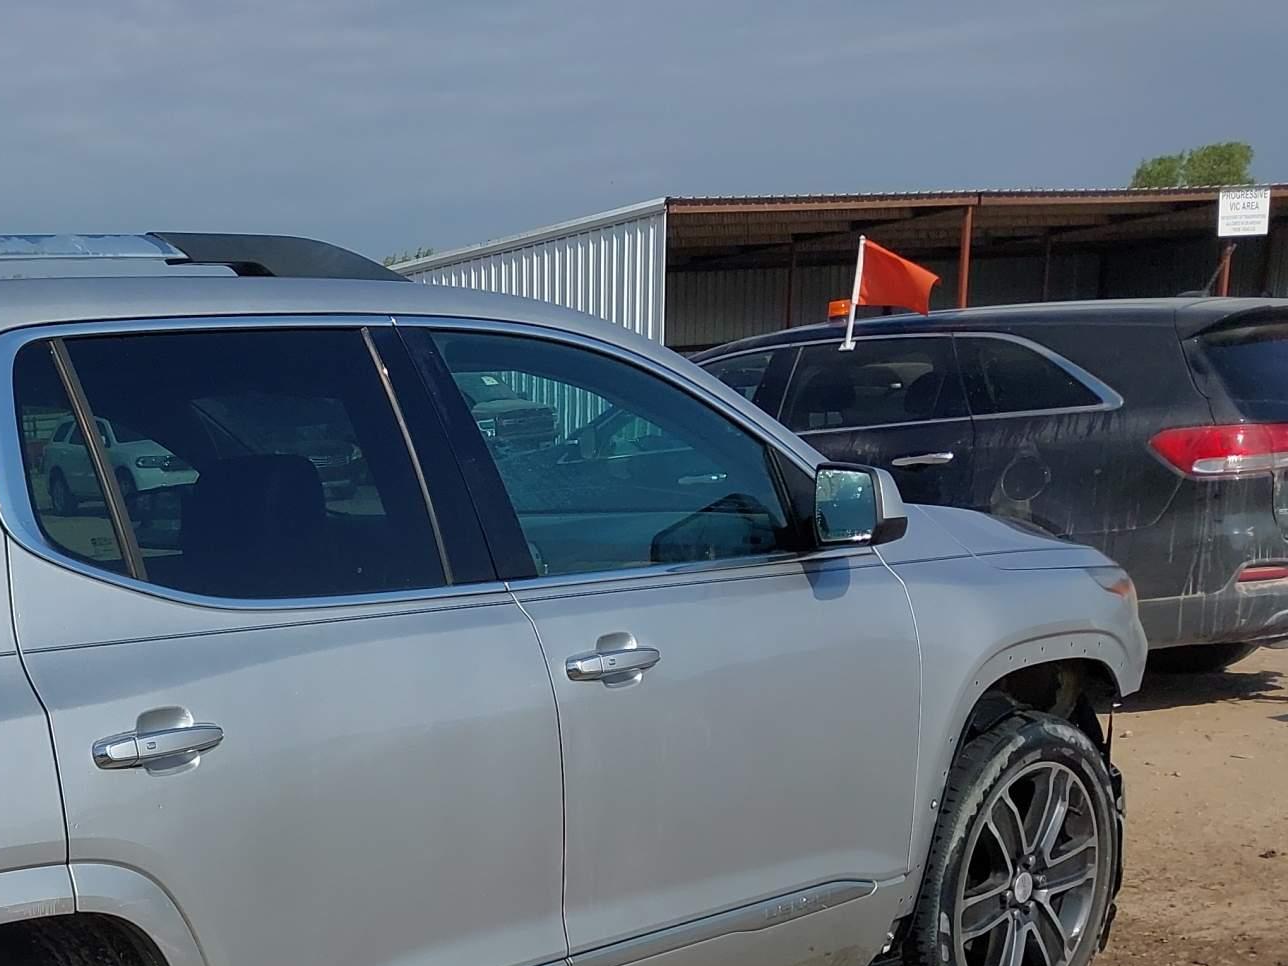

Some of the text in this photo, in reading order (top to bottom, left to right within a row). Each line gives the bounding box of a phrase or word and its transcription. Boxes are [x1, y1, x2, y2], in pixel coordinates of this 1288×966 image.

[1222, 189, 1268, 200] PROGRESSIVE
[1229, 201, 1259, 211] VIC AREA
